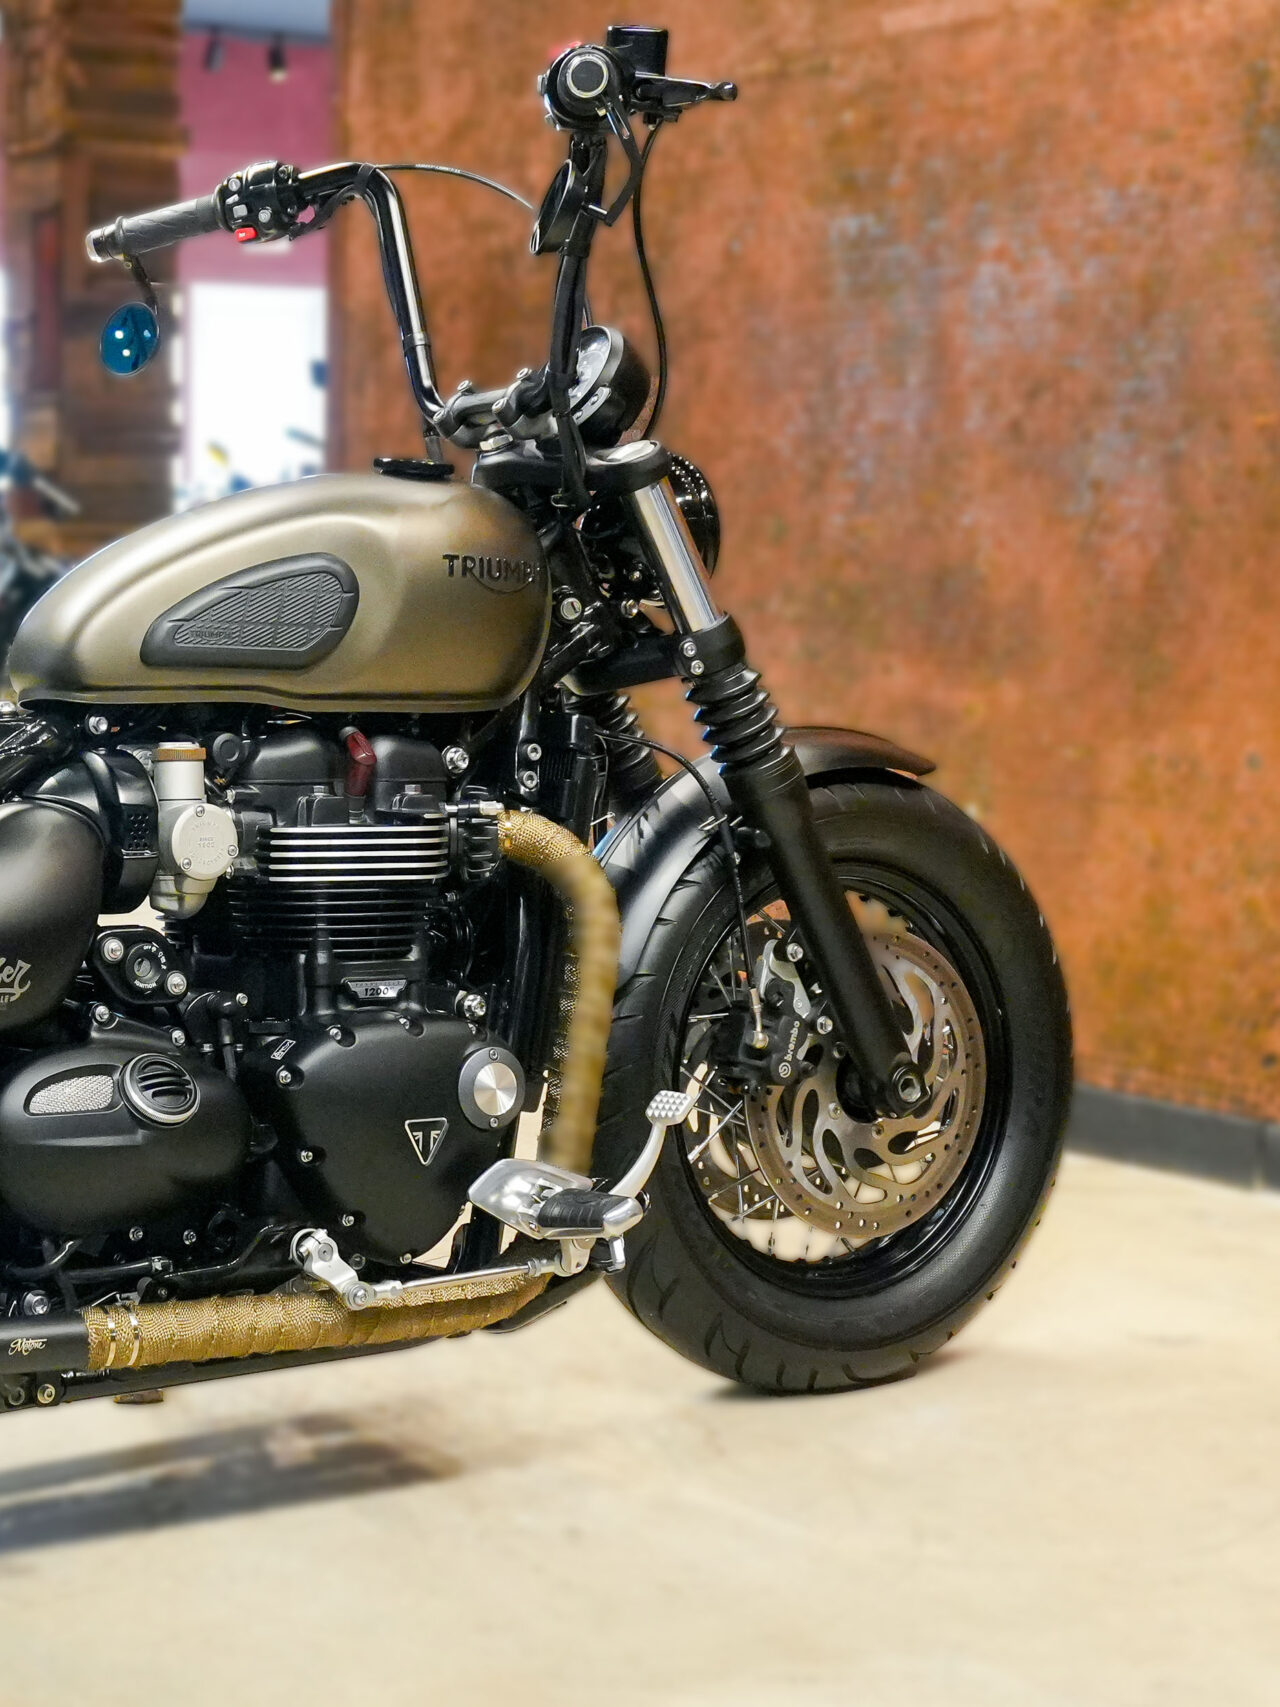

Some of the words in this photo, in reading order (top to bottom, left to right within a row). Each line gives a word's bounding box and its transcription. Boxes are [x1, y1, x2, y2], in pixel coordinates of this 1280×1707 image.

[442, 554, 541, 593] TRIUMPH
[364, 987, 389, 996] 1200
[784, 1020, 801, 1062] brembo
